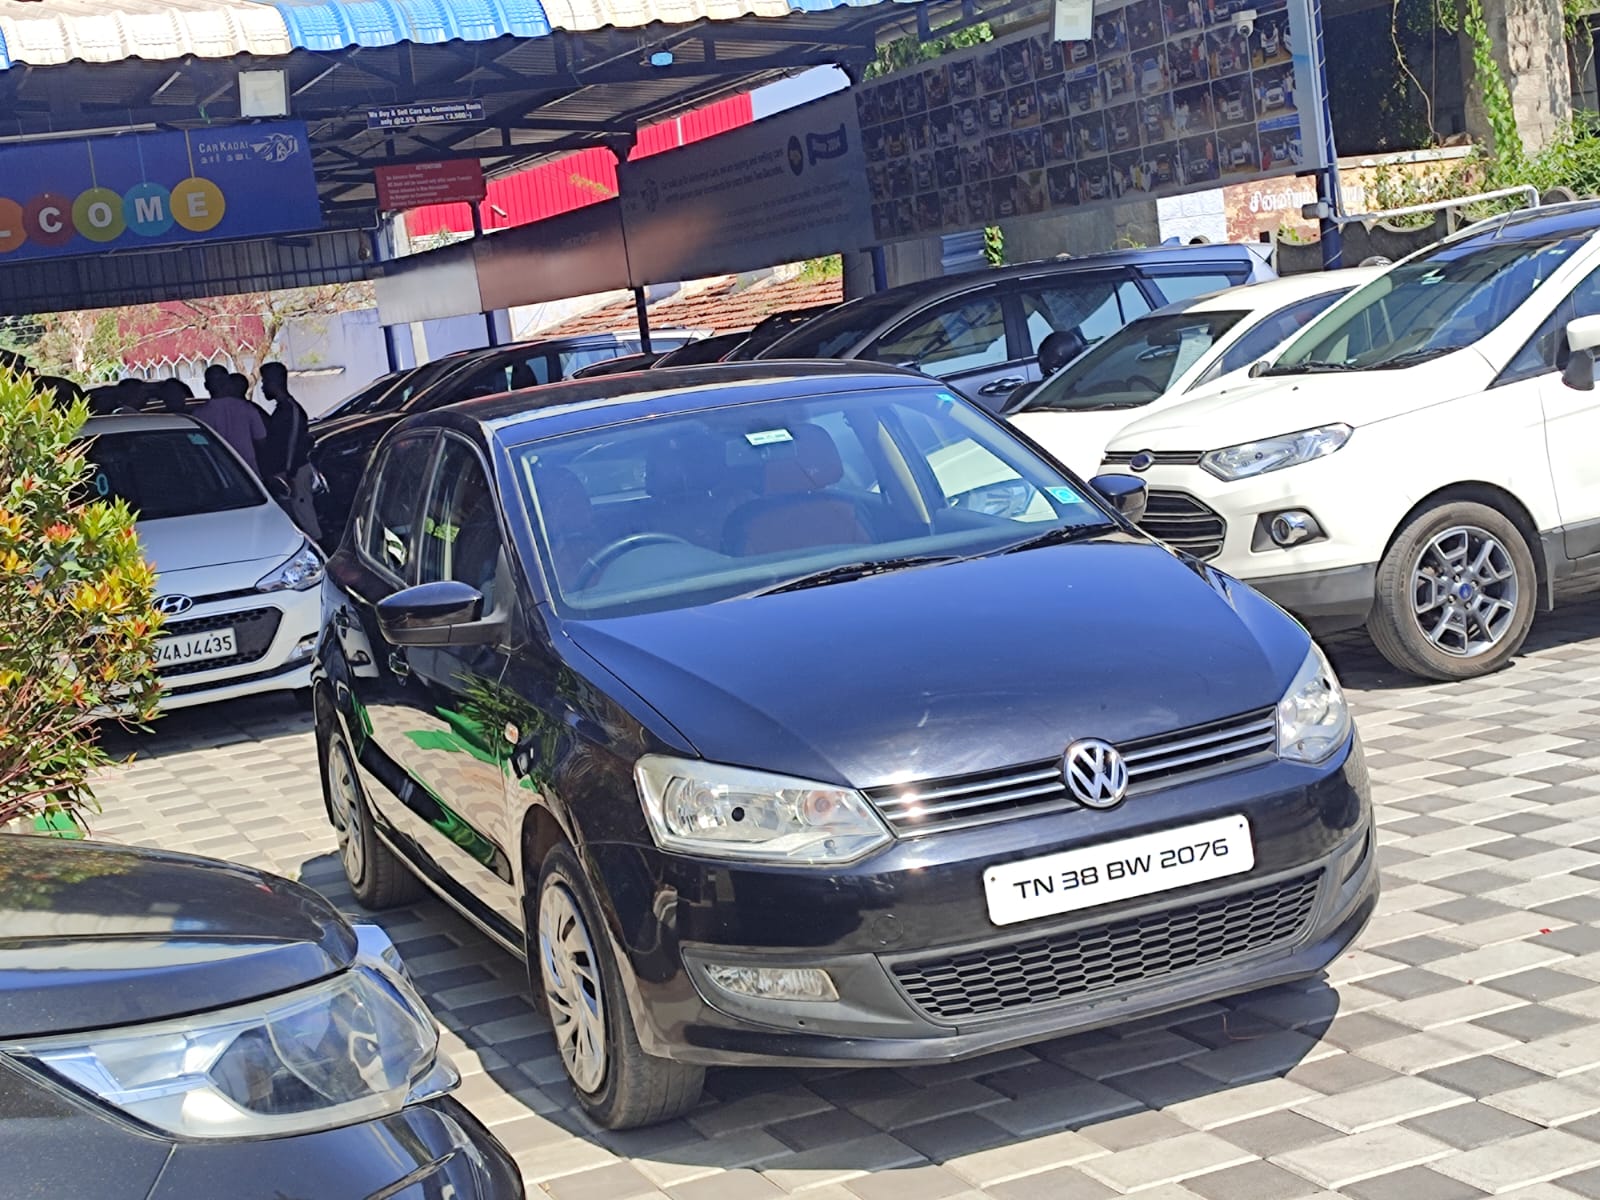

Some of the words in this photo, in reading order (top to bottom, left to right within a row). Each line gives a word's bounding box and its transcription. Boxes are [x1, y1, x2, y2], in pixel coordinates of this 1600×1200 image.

[0, 192, 208, 237] COME
[1013, 875, 1054, 899] TN
[1061, 865, 1100, 891] 38
[1106, 854, 1151, 881] BW
[1160, 838, 1229, 869] 2076
